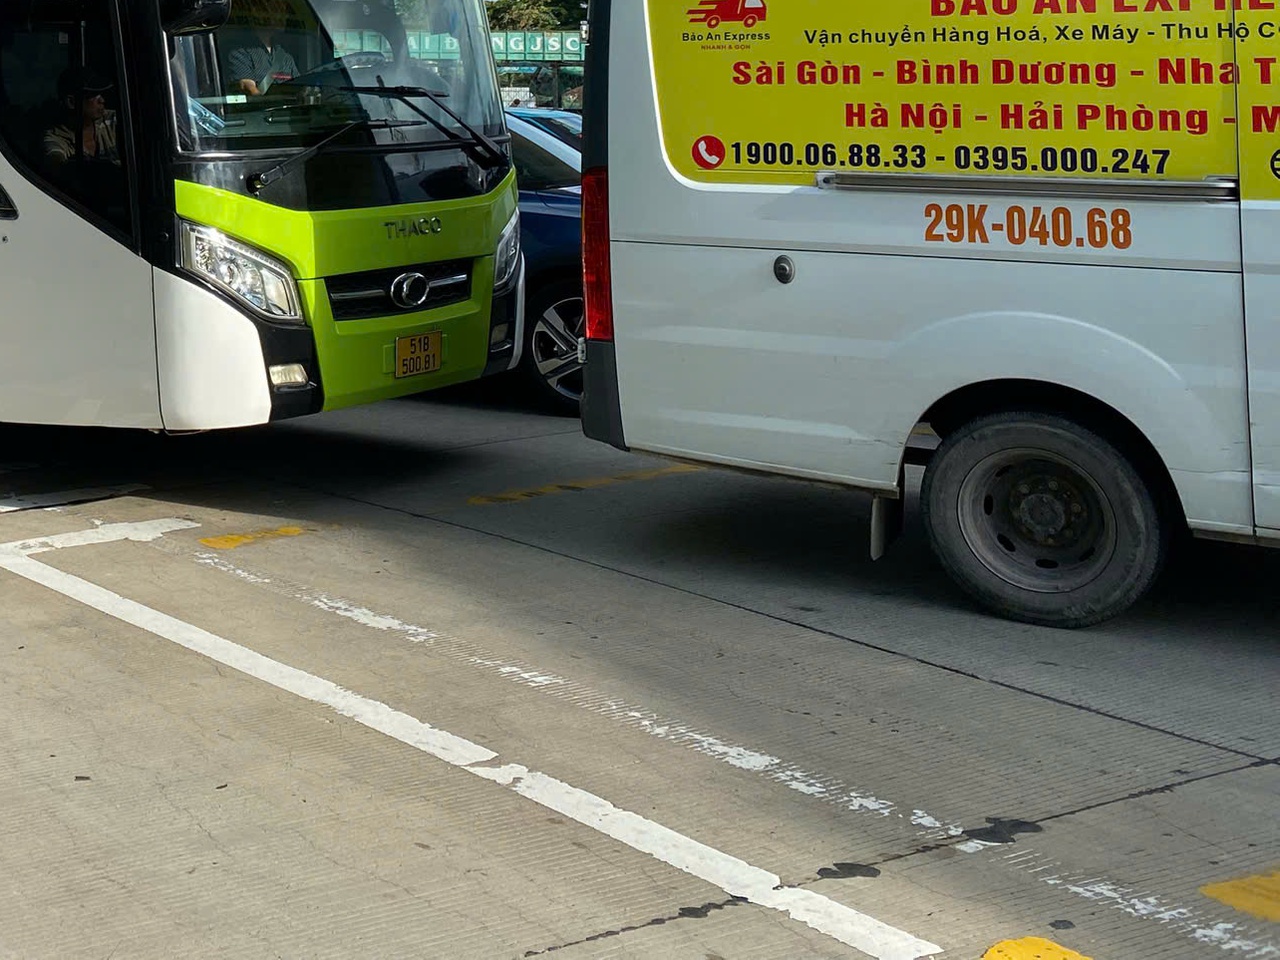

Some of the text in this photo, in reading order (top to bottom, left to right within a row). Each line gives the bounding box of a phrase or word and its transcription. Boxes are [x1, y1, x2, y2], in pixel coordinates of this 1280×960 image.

[682, 31, 770, 42] Bảo An Express
[804, 29, 842, 47] Vận
[849, 24, 926, 46] chuyển
[932, 26, 989, 45] Hàng
[996, 25, 1048, 43] Hoá,
[1055, 25, 1084, 41] Xe
[1092, 24, 1139, 43] Máy
[1162, 23, 1208, 39] Thu
[1217, 23, 1250, 43] Hộ
[1258, 22, 1280, 38] C
[732, 60, 785, 85] Sài
[797, 60, 861, 85] Gòn
[896, 59, 979, 85] Bình
[992, 59, 1116, 87] Dương
[1158, 58, 1240, 85] Nha
[845, 102, 888, 127] Hà
[901, 102, 962, 134] Nội
[1001, 101, 1063, 130] Hải
[1077, 104, 1208, 135] Phòng
[731, 142, 926, 168] 1900.06.88.33
[954, 145, 1170, 174] 0395.000.247
[384, 216, 442, 239] THACO
[924, 203, 1132, 249] 29K-040.68
[410, 336, 429, 354] 51B
[402, 354, 436, 375] 500.81
